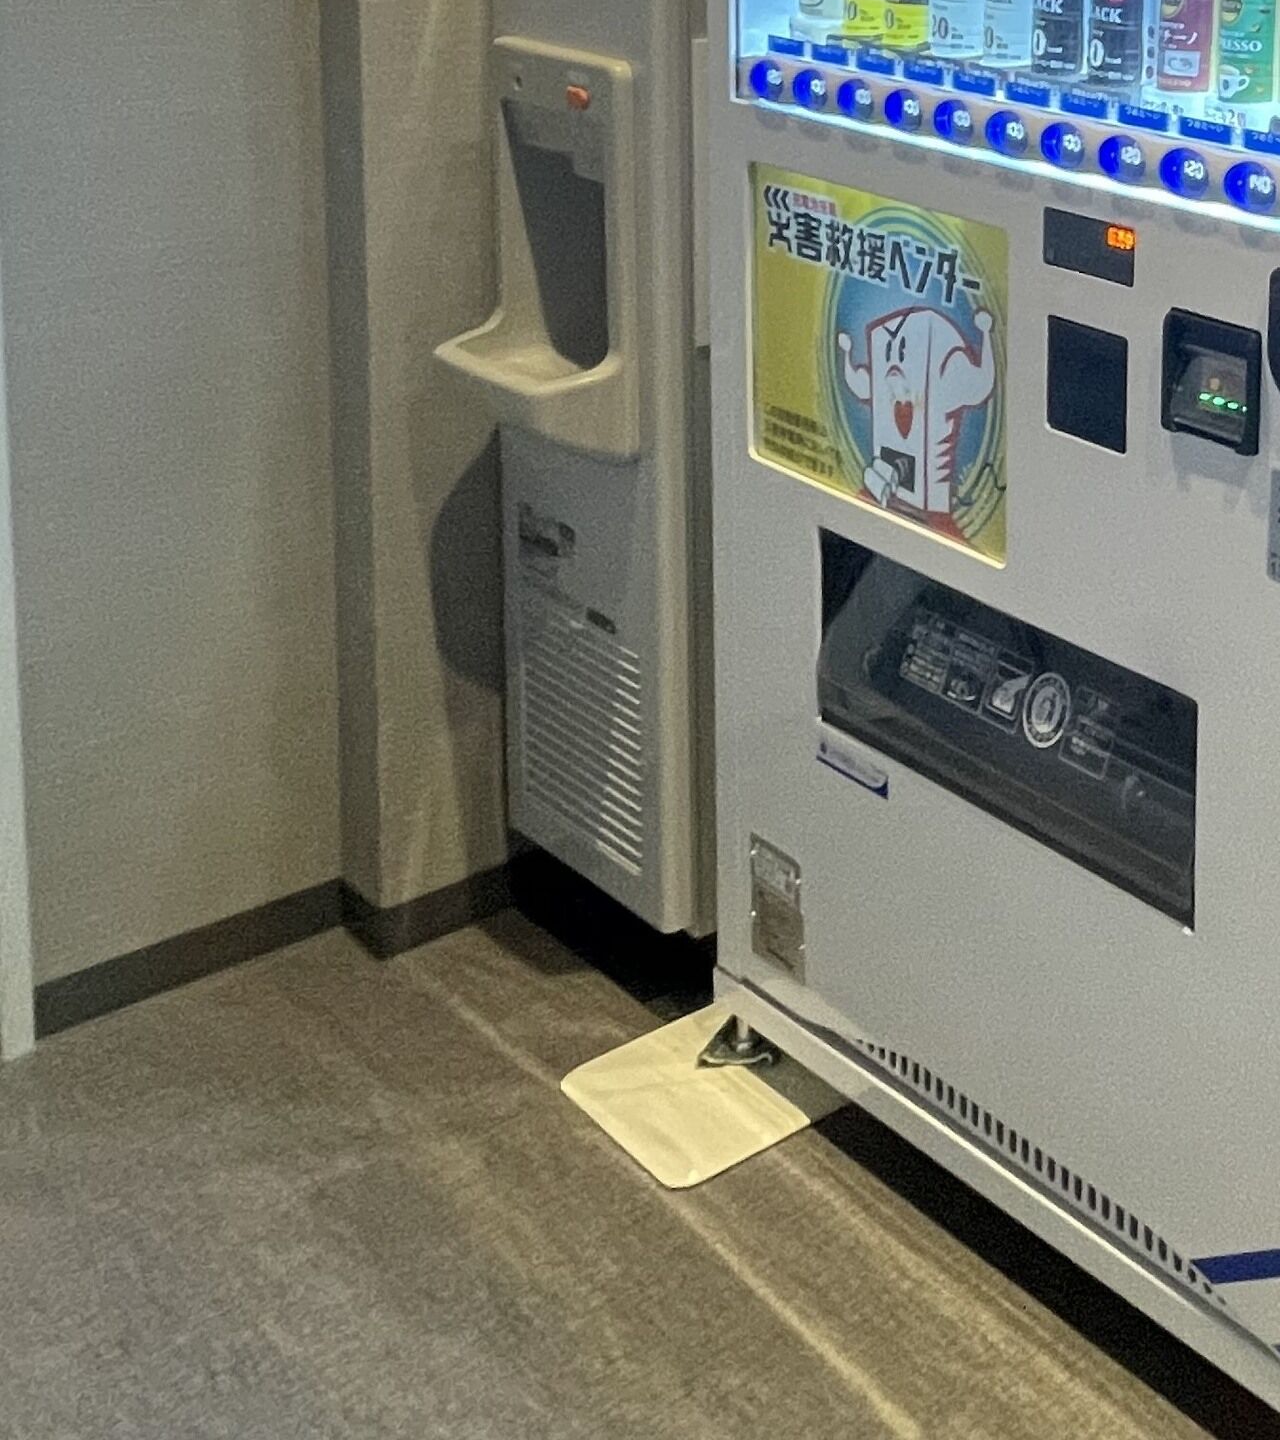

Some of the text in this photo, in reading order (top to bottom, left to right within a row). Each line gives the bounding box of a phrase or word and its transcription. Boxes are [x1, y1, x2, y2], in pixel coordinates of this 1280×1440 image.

[764, 185, 981, 304] 災害救援ベンダー
